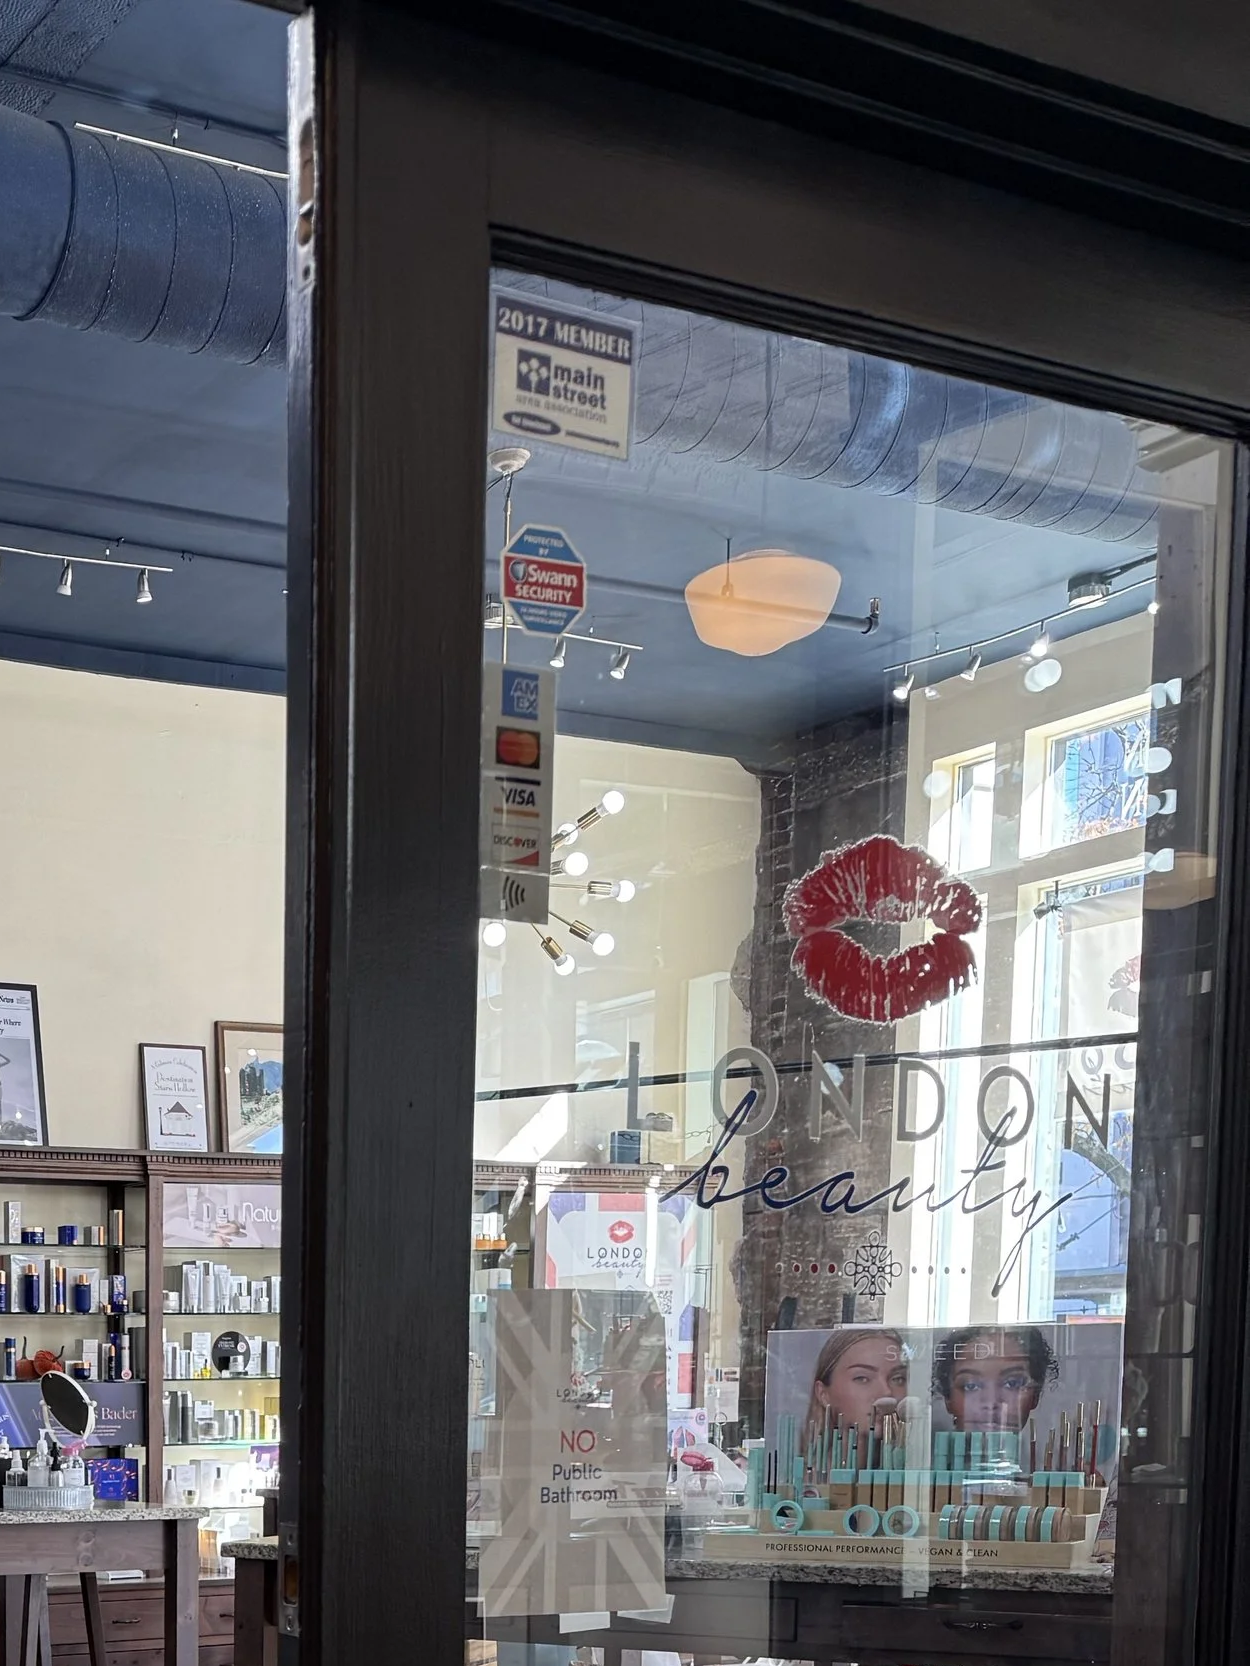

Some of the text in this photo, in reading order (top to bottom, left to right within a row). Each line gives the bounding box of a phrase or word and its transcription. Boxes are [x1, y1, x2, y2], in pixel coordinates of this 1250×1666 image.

[499, 307, 631, 359] 2017 MEMBER
[554, 364, 605, 390] main
[552, 383, 607, 410] street
[544, 399, 607, 424] association
[524, 534, 564, 548] PROTECTED
[528, 564, 578, 588] Swann
[515, 584, 572, 603] SECURITY
[502, 787, 536, 807] VISA
[627, 1041, 1112, 1150] LONDON
[661, 1089, 1073, 1298] beauty
[587, 1247, 643, 1259] LONDO
[102, 1408, 138, 1420] Bader
[560, 1430, 596, 1453] NO
[552, 1463, 602, 1481] Public
[540, 1487, 618, 1504] Bathroom
[766, 1543, 832, 1553] PROFESSIONAL
[836, 1545, 905, 1555] PERFORMANCE
[918, 1547, 953, 1557] VEGAN
[966, 1549, 998, 1557] CLEAN
